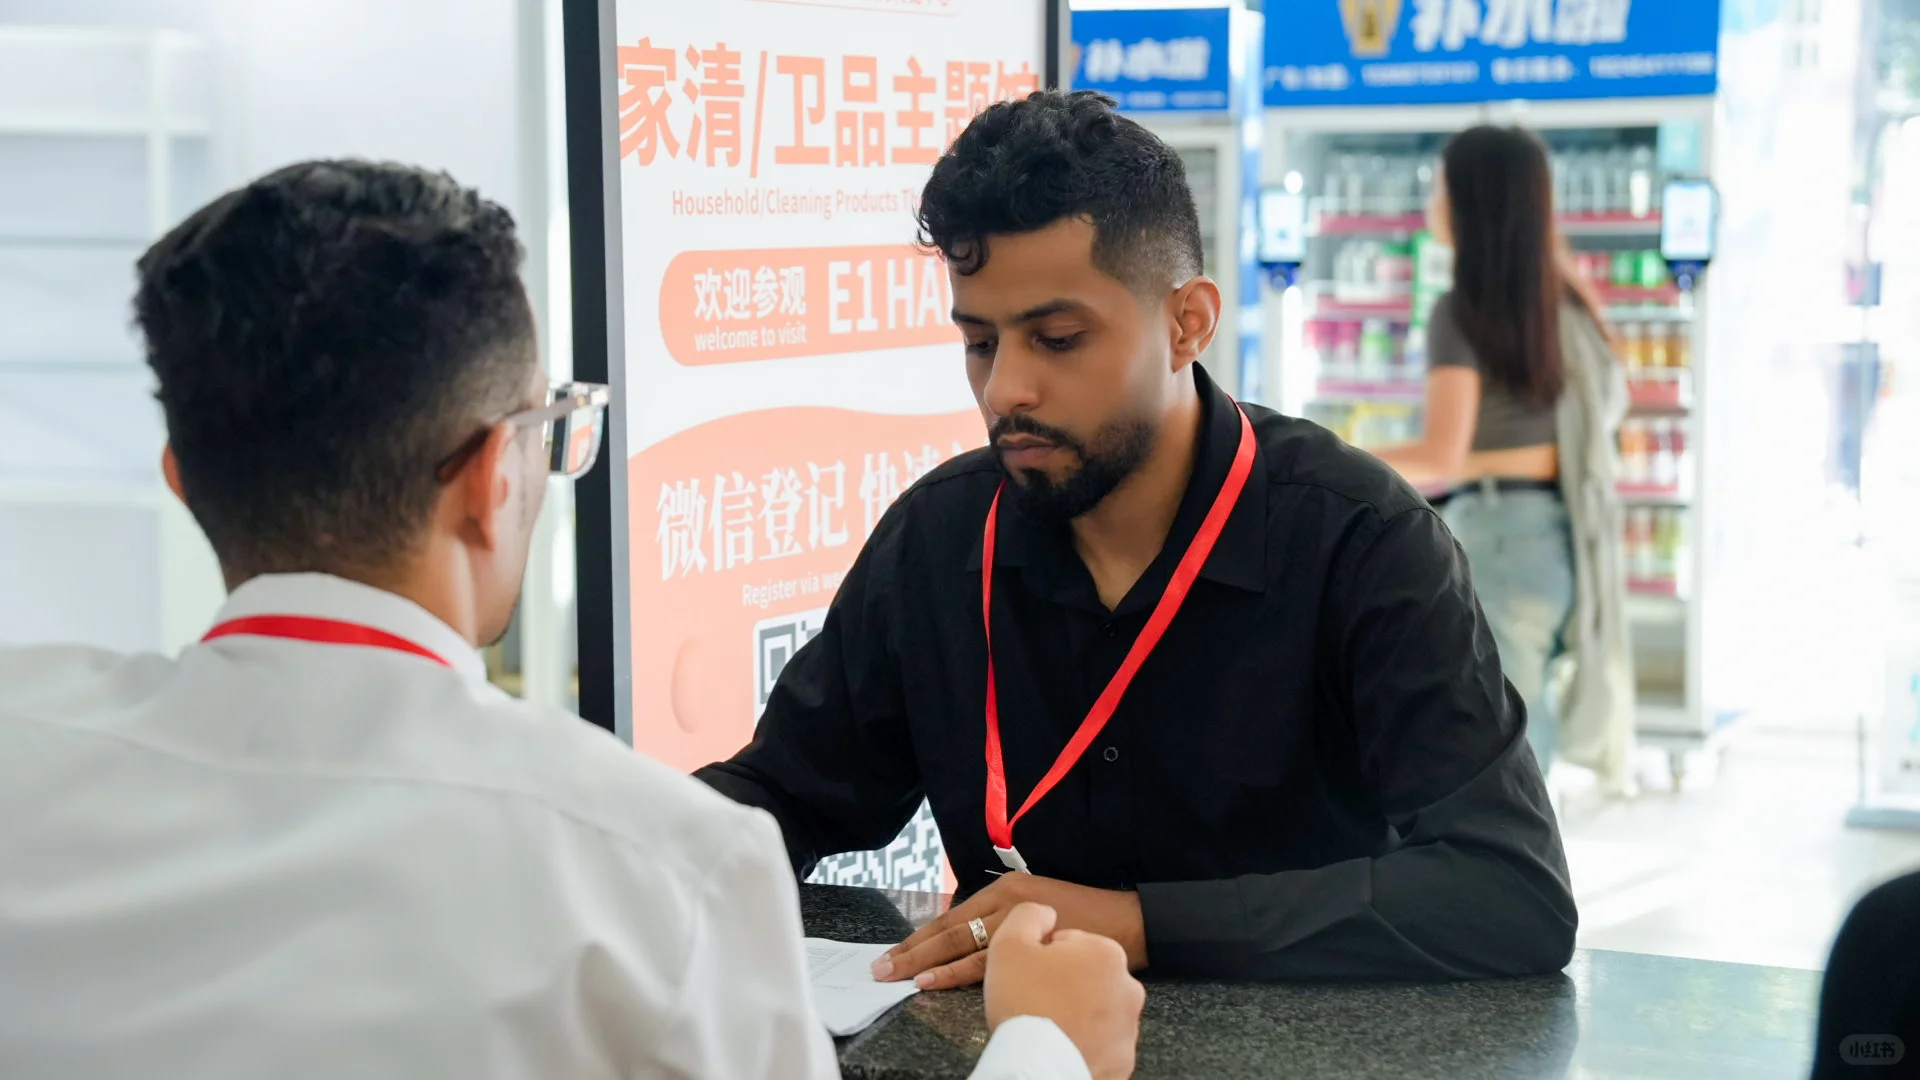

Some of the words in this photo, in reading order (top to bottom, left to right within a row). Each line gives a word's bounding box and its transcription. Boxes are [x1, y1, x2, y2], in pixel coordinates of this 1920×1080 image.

[672, 189, 831, 219] Household/Cleaning
[836, 187, 898, 213] Products
[901, 186, 921, 214] Th
[693, 265, 807, 322] 欢迎参观
[694, 325, 757, 351] welcome
[760, 327, 776, 346] to
[778, 321, 807, 345] visit
[655, 459, 850, 582] 微信登记
[742, 578, 798, 609] Register
[800, 571, 820, 594] via
